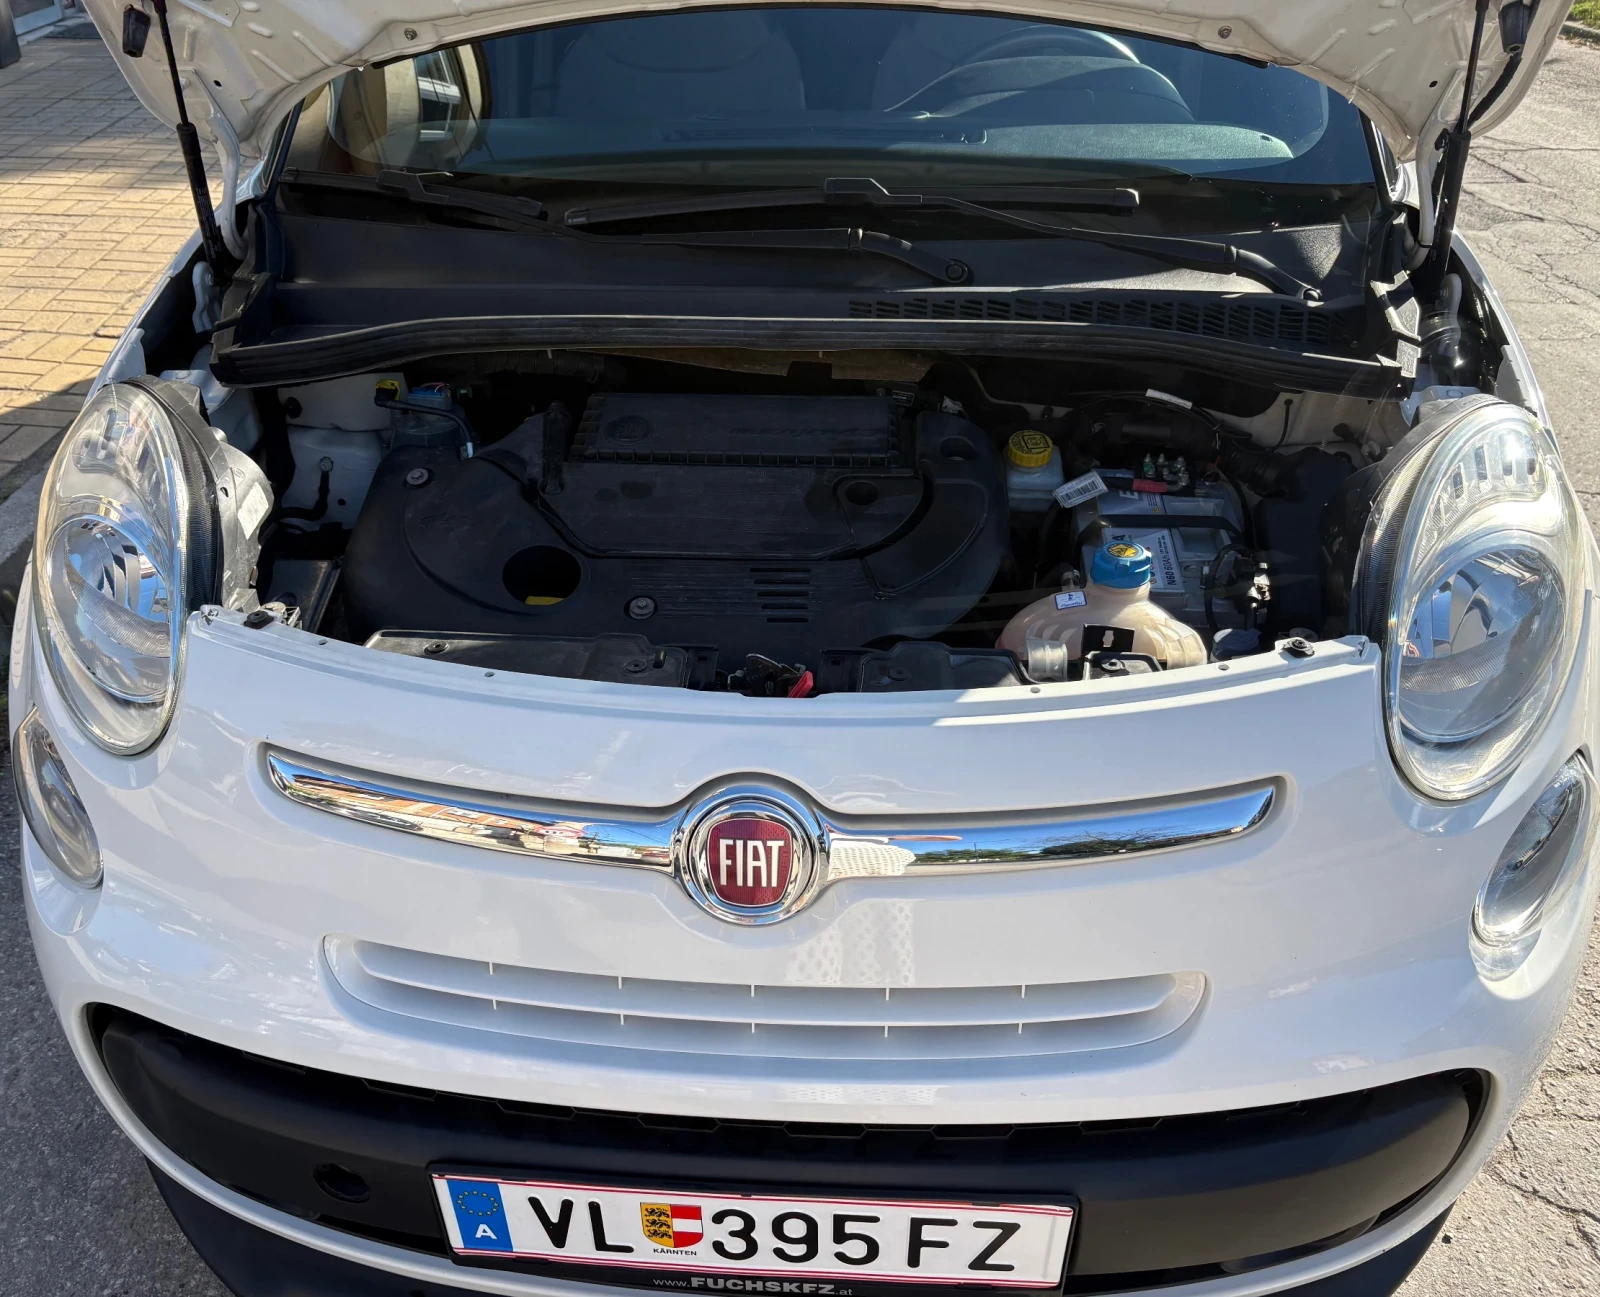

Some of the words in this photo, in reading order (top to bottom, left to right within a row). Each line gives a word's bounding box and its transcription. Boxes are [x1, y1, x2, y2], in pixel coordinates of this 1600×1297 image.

[1165, 571, 1177, 586] N60
[719, 838, 785, 888] FIAT
[475, 1223, 498, 1240] A
[527, 1196, 634, 1254] VL
[711, 1208, 881, 1266] 395
[907, 1217, 1022, 1272] FZ
[653, 1247, 697, 1256] KÄRNTEN
[653, 1276, 853, 1296] www.FUCHSKFZ.at
